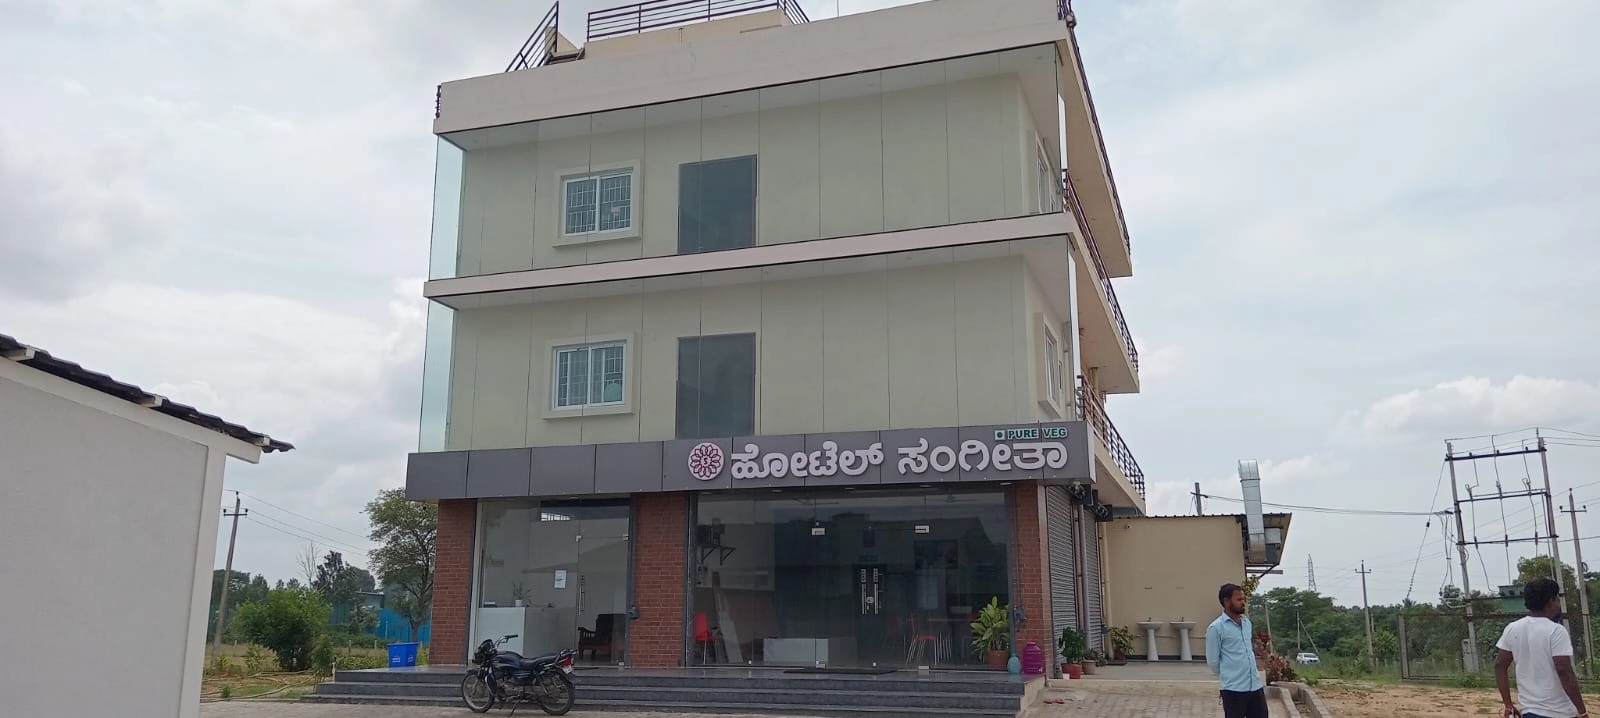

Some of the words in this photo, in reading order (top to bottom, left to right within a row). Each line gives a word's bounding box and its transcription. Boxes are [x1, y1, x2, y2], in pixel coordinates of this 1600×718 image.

[1007, 429, 1039, 439] PURE
[1042, 427, 1068, 438] VEG
[731, 440, 884, 479] ಹೋಟೆಲ್
[897, 437, 1068, 474] ಸಂಗೀತಾ
